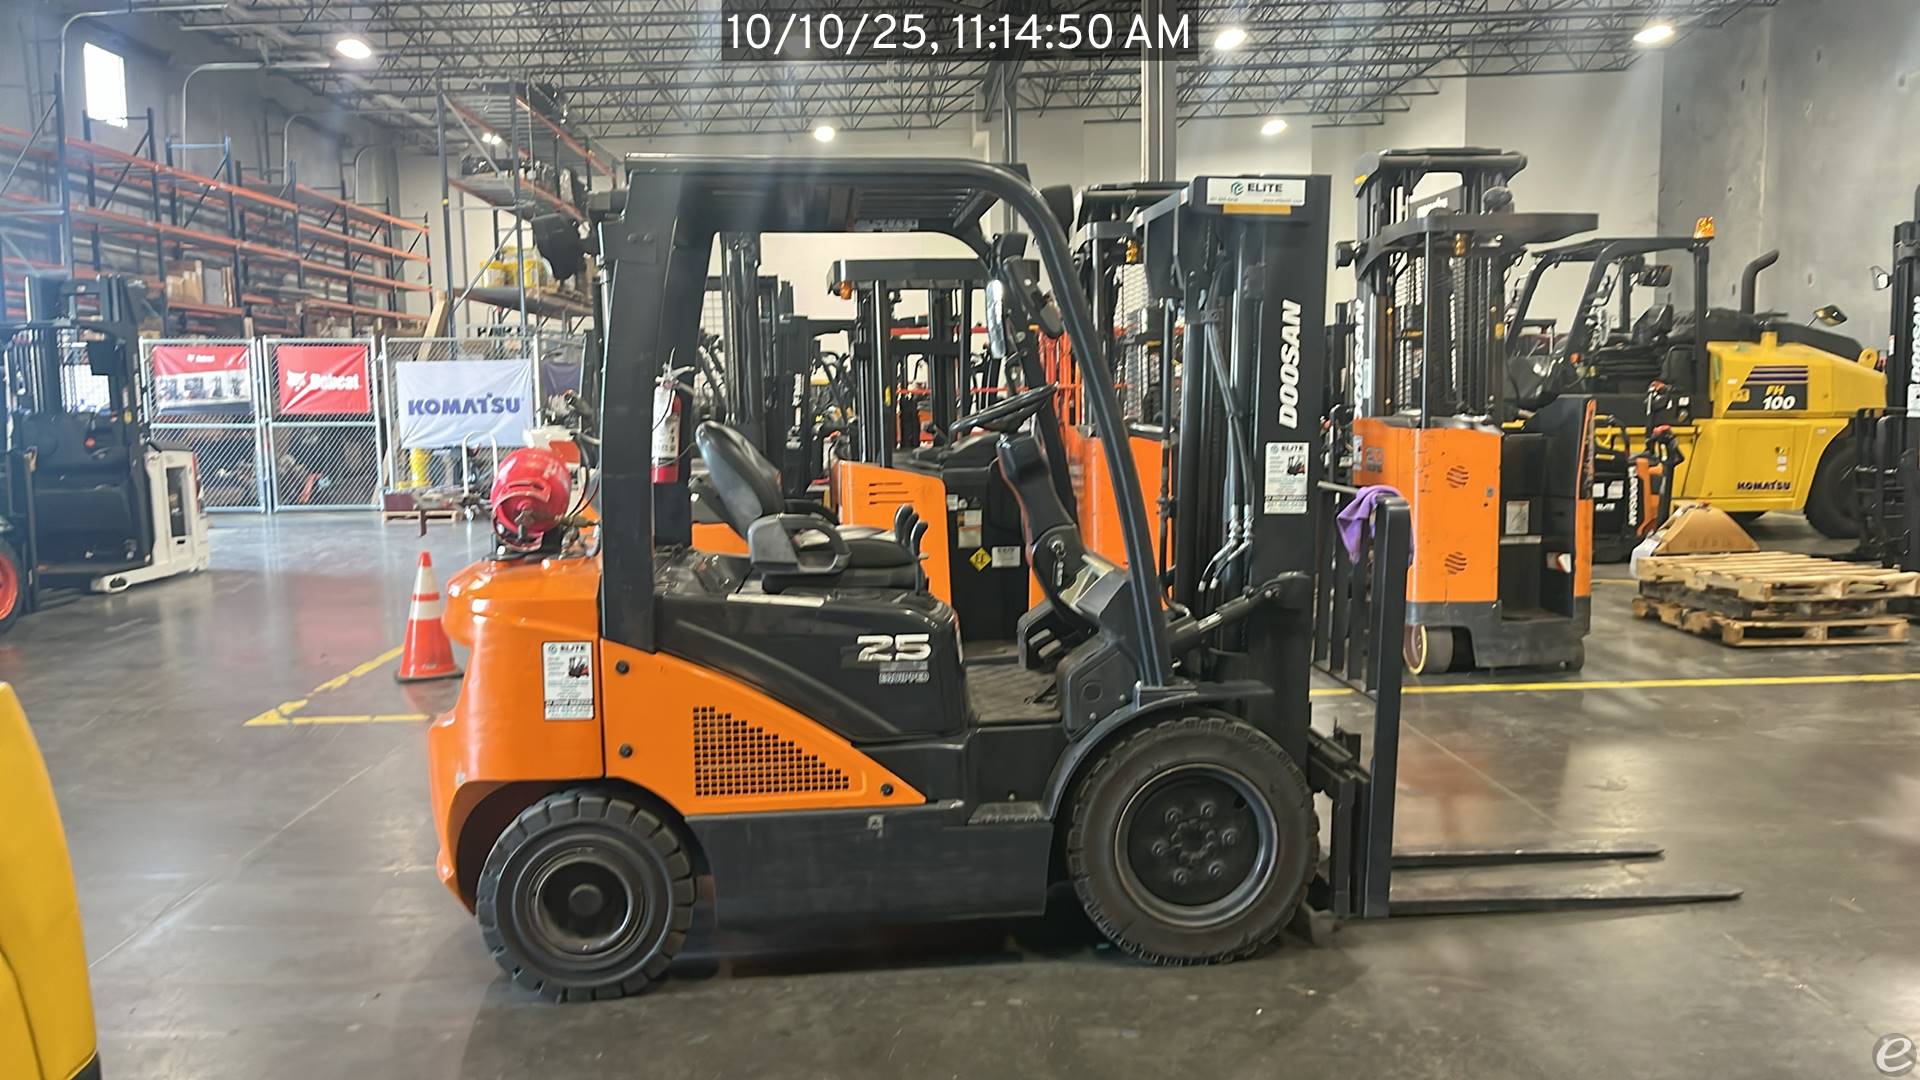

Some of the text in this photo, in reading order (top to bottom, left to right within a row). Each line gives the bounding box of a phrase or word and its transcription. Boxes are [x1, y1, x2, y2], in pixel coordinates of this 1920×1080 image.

[1247, 182, 1284, 193] ELITE
[1279, 299, 1301, 429] DOOSAN
[310, 372, 360, 391] Bobcat
[1765, 384, 1786, 396] FH
[407, 392, 522, 416] KOMATSU
[1763, 395, 1797, 411] 100
[1737, 480, 1792, 491] KOMATSU
[857, 633, 931, 662] 25
[879, 671, 930, 685] EQUIPPED
